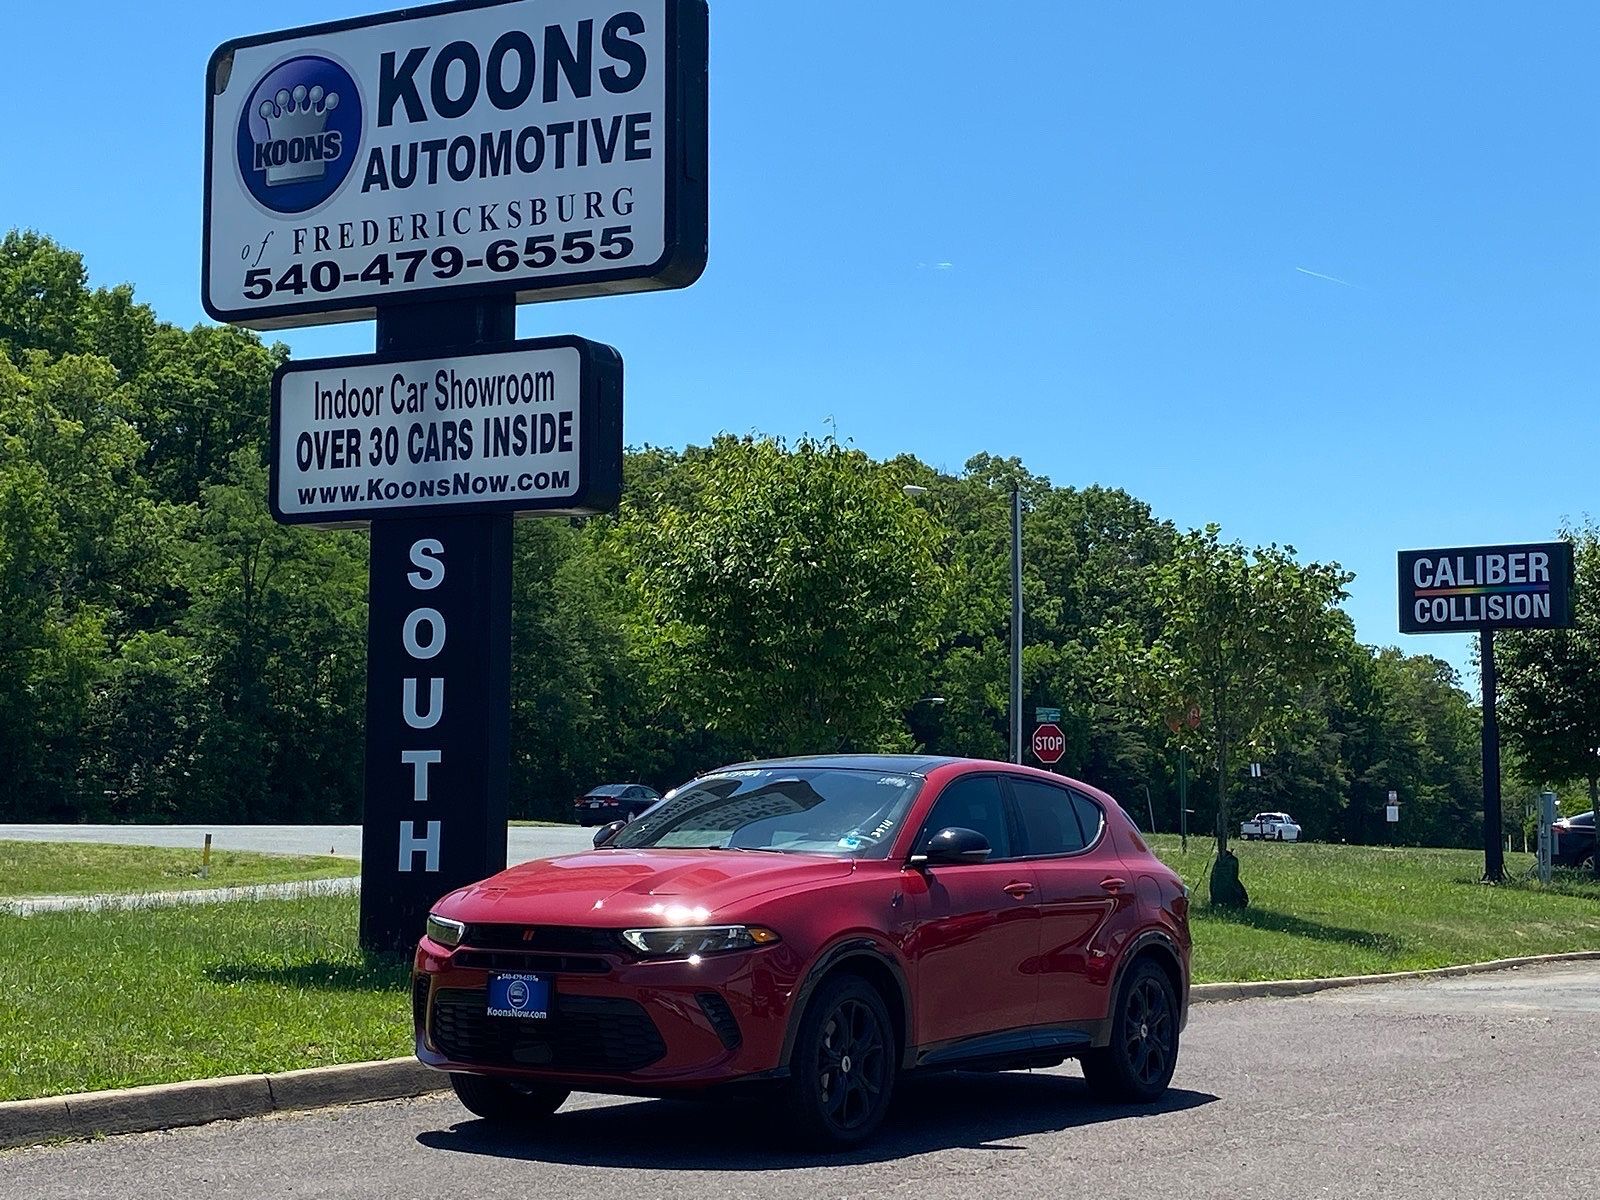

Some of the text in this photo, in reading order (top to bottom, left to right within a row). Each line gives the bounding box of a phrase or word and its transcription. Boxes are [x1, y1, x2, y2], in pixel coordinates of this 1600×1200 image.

[377, 11, 647, 128] KOONS
[254, 130, 341, 170] KOONS
[361, 111, 652, 194] AUTOMOTIVE
[241, 187, 635, 267] of FREDERICKSBURG
[243, 225, 634, 300] 540-479-6555
[314, 368, 555, 421] Indoor Car Showroom
[296, 410, 574, 472] OVER 30 CARS INSIDE
[1413, 552, 1550, 588] CALIBER
[1414, 593, 1551, 624] COLLISION
[398, 538, 447, 872] SOUTH
[1035, 736, 1063, 751] STOP
[487, 1007, 546, 1018] KoonsNow.com
